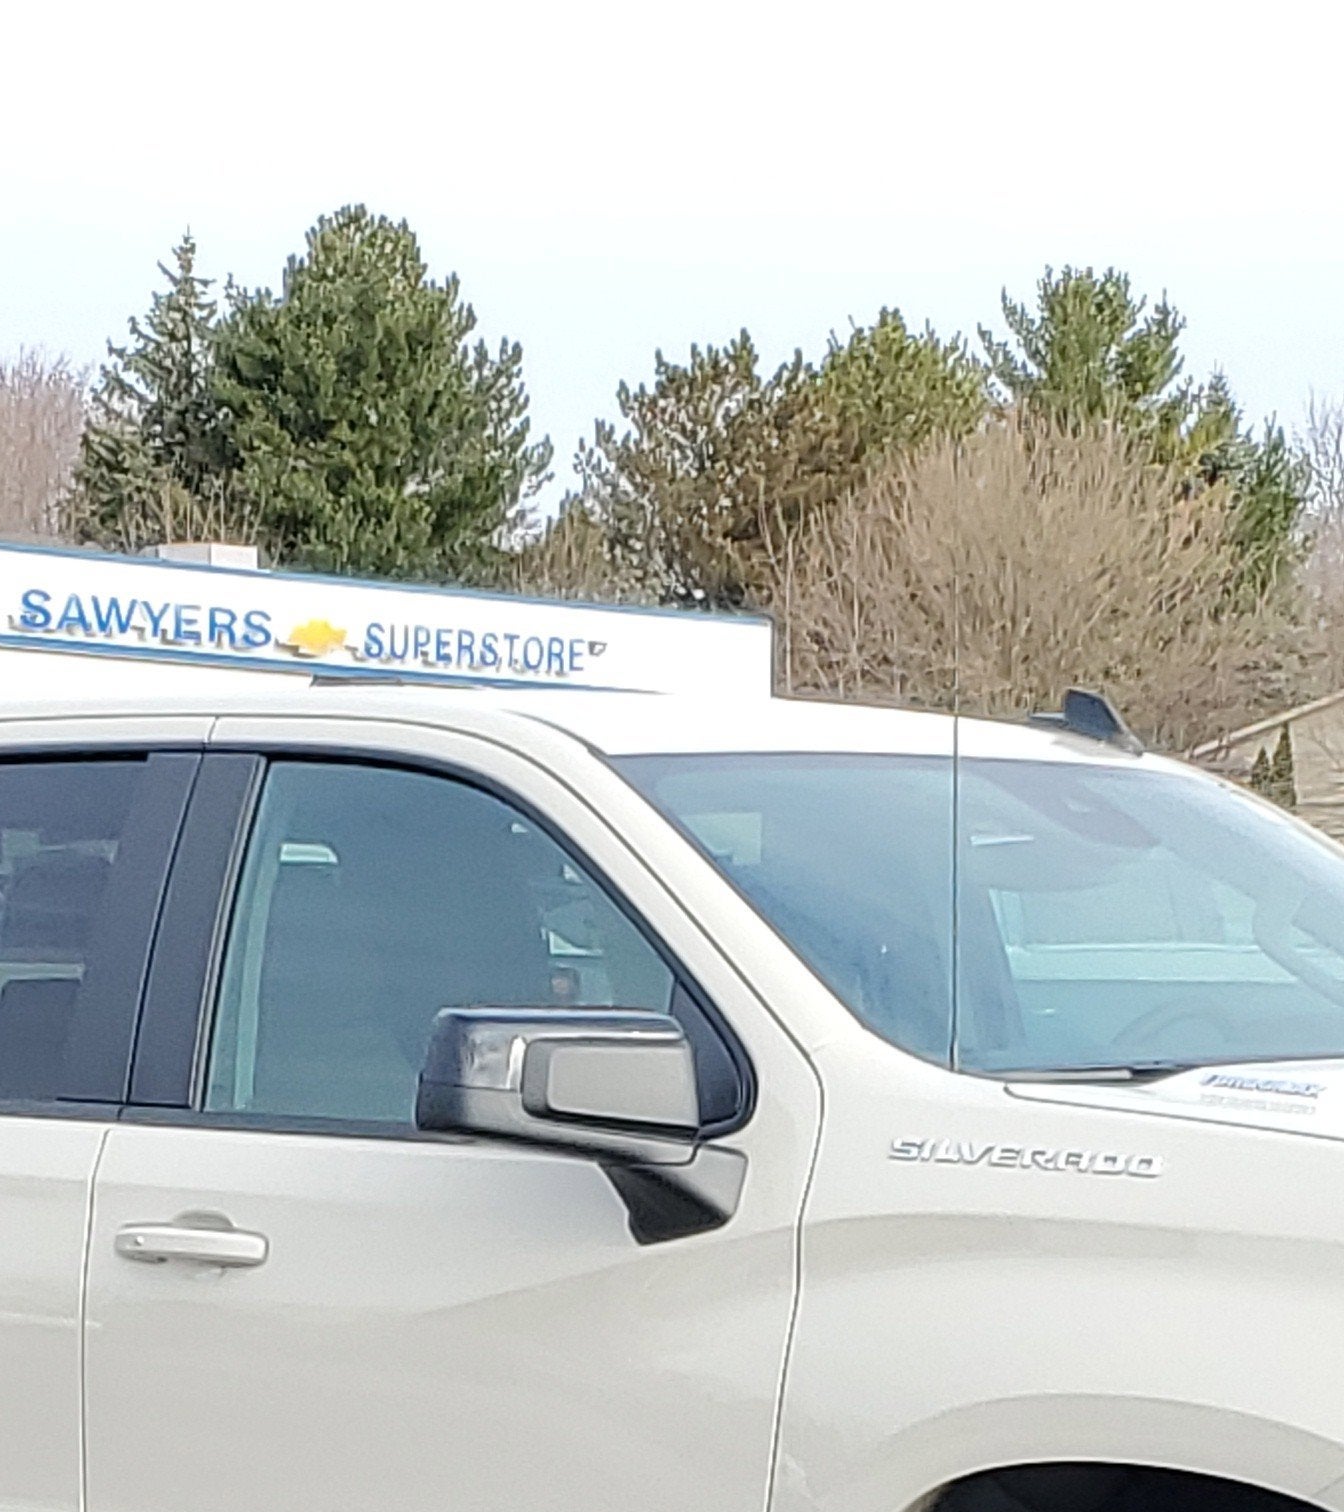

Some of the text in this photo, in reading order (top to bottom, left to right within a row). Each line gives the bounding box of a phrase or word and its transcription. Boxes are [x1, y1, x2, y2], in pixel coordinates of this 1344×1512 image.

[20, 589, 585, 673] SAWYERS SUPERSTORE
[888, 1137, 1164, 1178] SILVERADO
